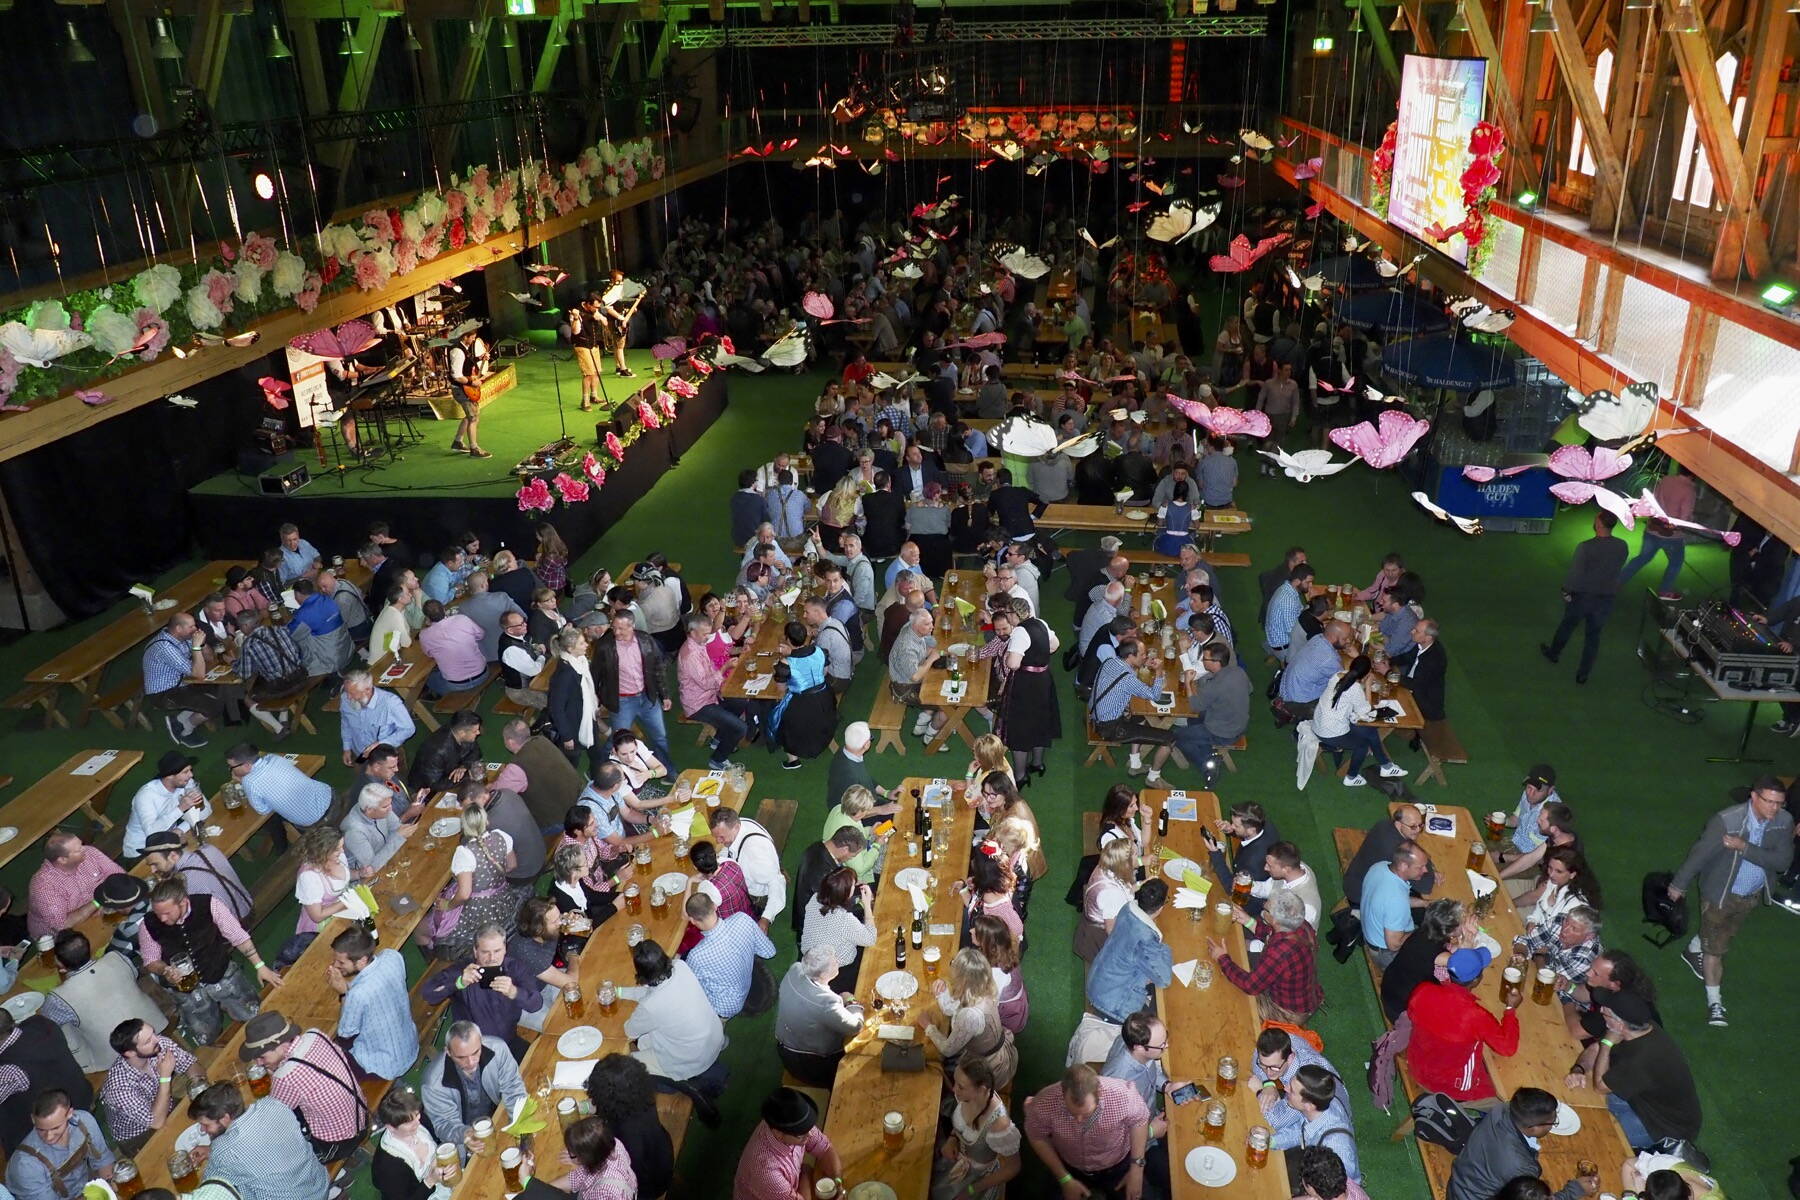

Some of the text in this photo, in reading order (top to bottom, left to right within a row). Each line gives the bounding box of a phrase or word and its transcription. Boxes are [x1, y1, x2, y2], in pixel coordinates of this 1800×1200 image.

[1432, 378, 1472, 387] HALDENGUT
[1476, 484, 1521, 493] HALDEN
[1486, 492, 1508, 500] GUT
